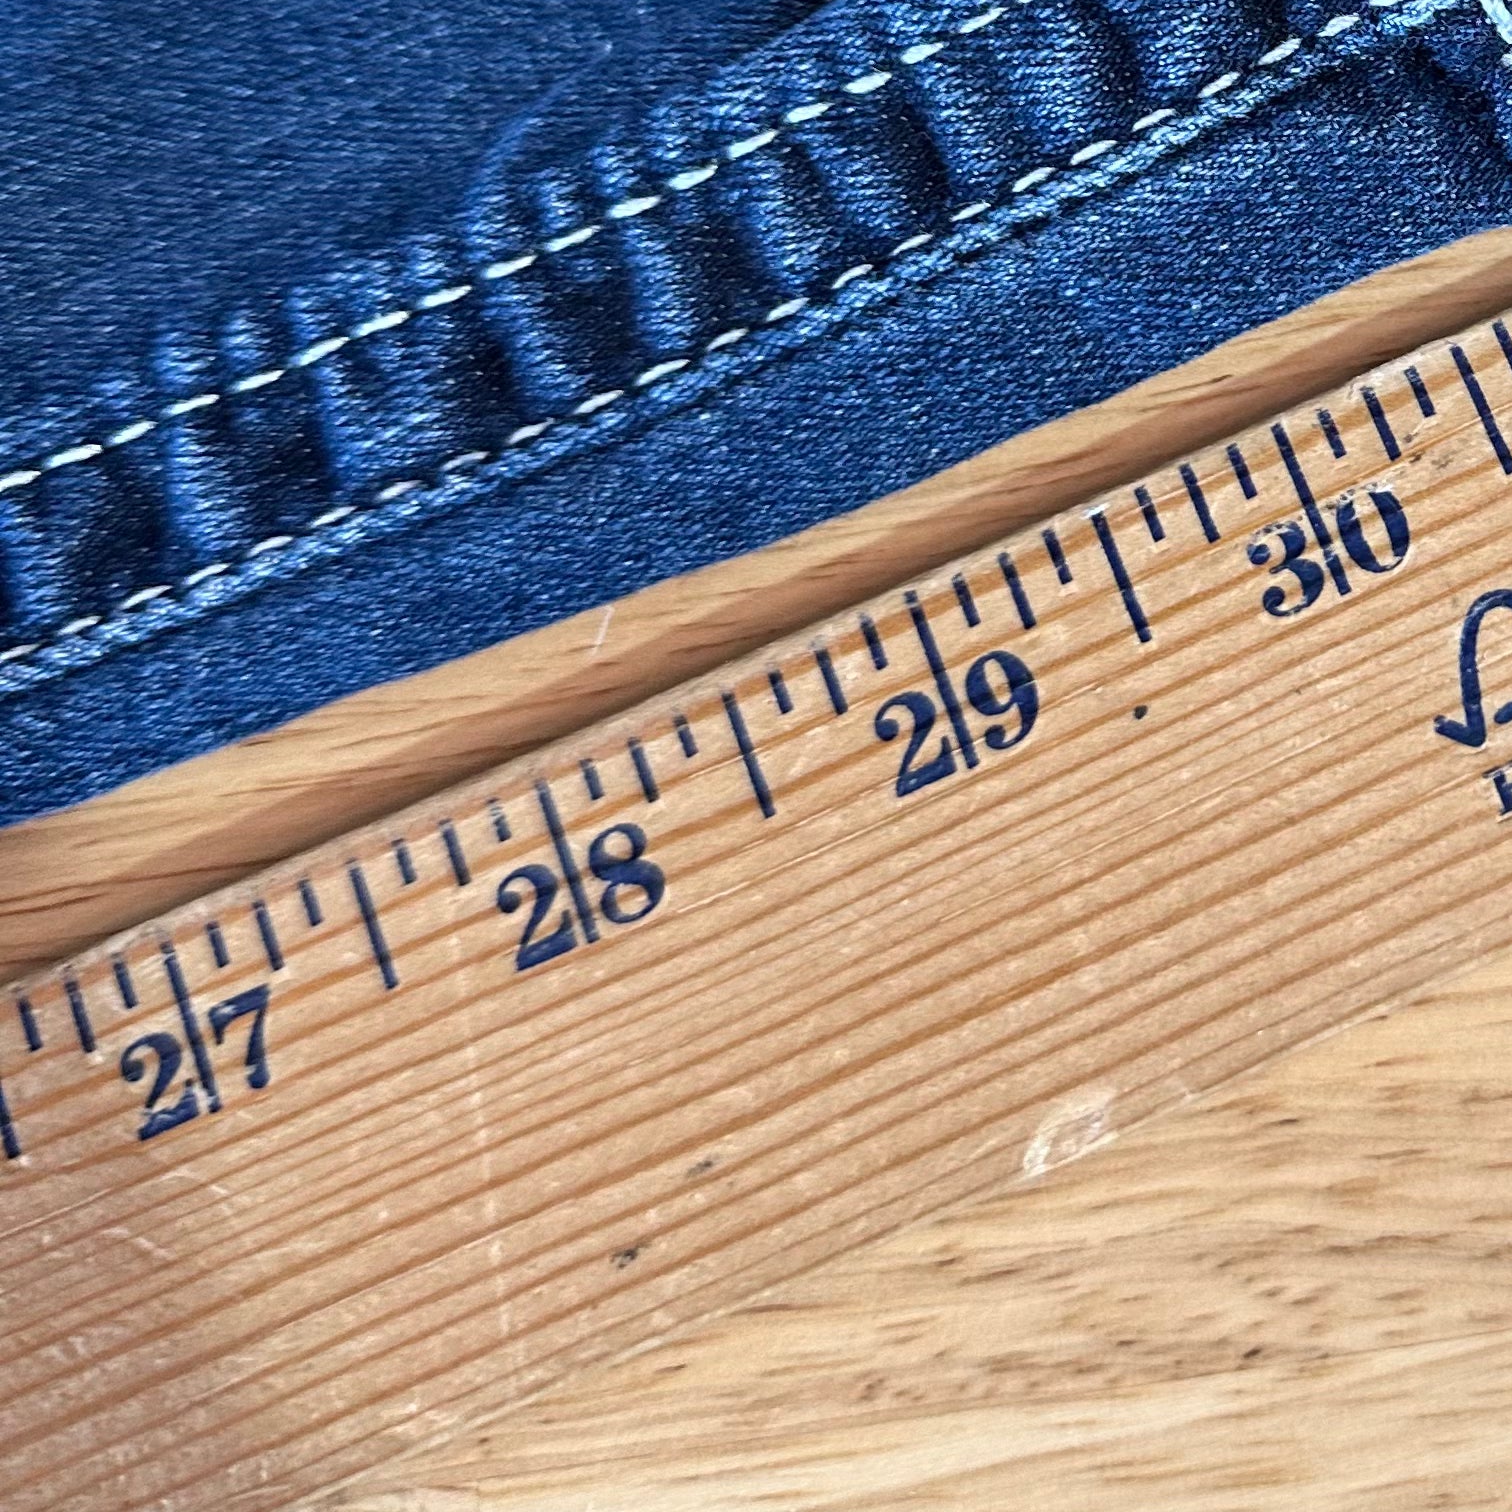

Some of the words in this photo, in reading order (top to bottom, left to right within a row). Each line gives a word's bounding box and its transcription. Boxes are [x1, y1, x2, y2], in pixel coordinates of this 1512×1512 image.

[1246, 486, 1412, 618] 30
[873, 649, 1041, 799] 29
[496, 822, 668, 972] 28
[119, 984, 272, 1141] 27
